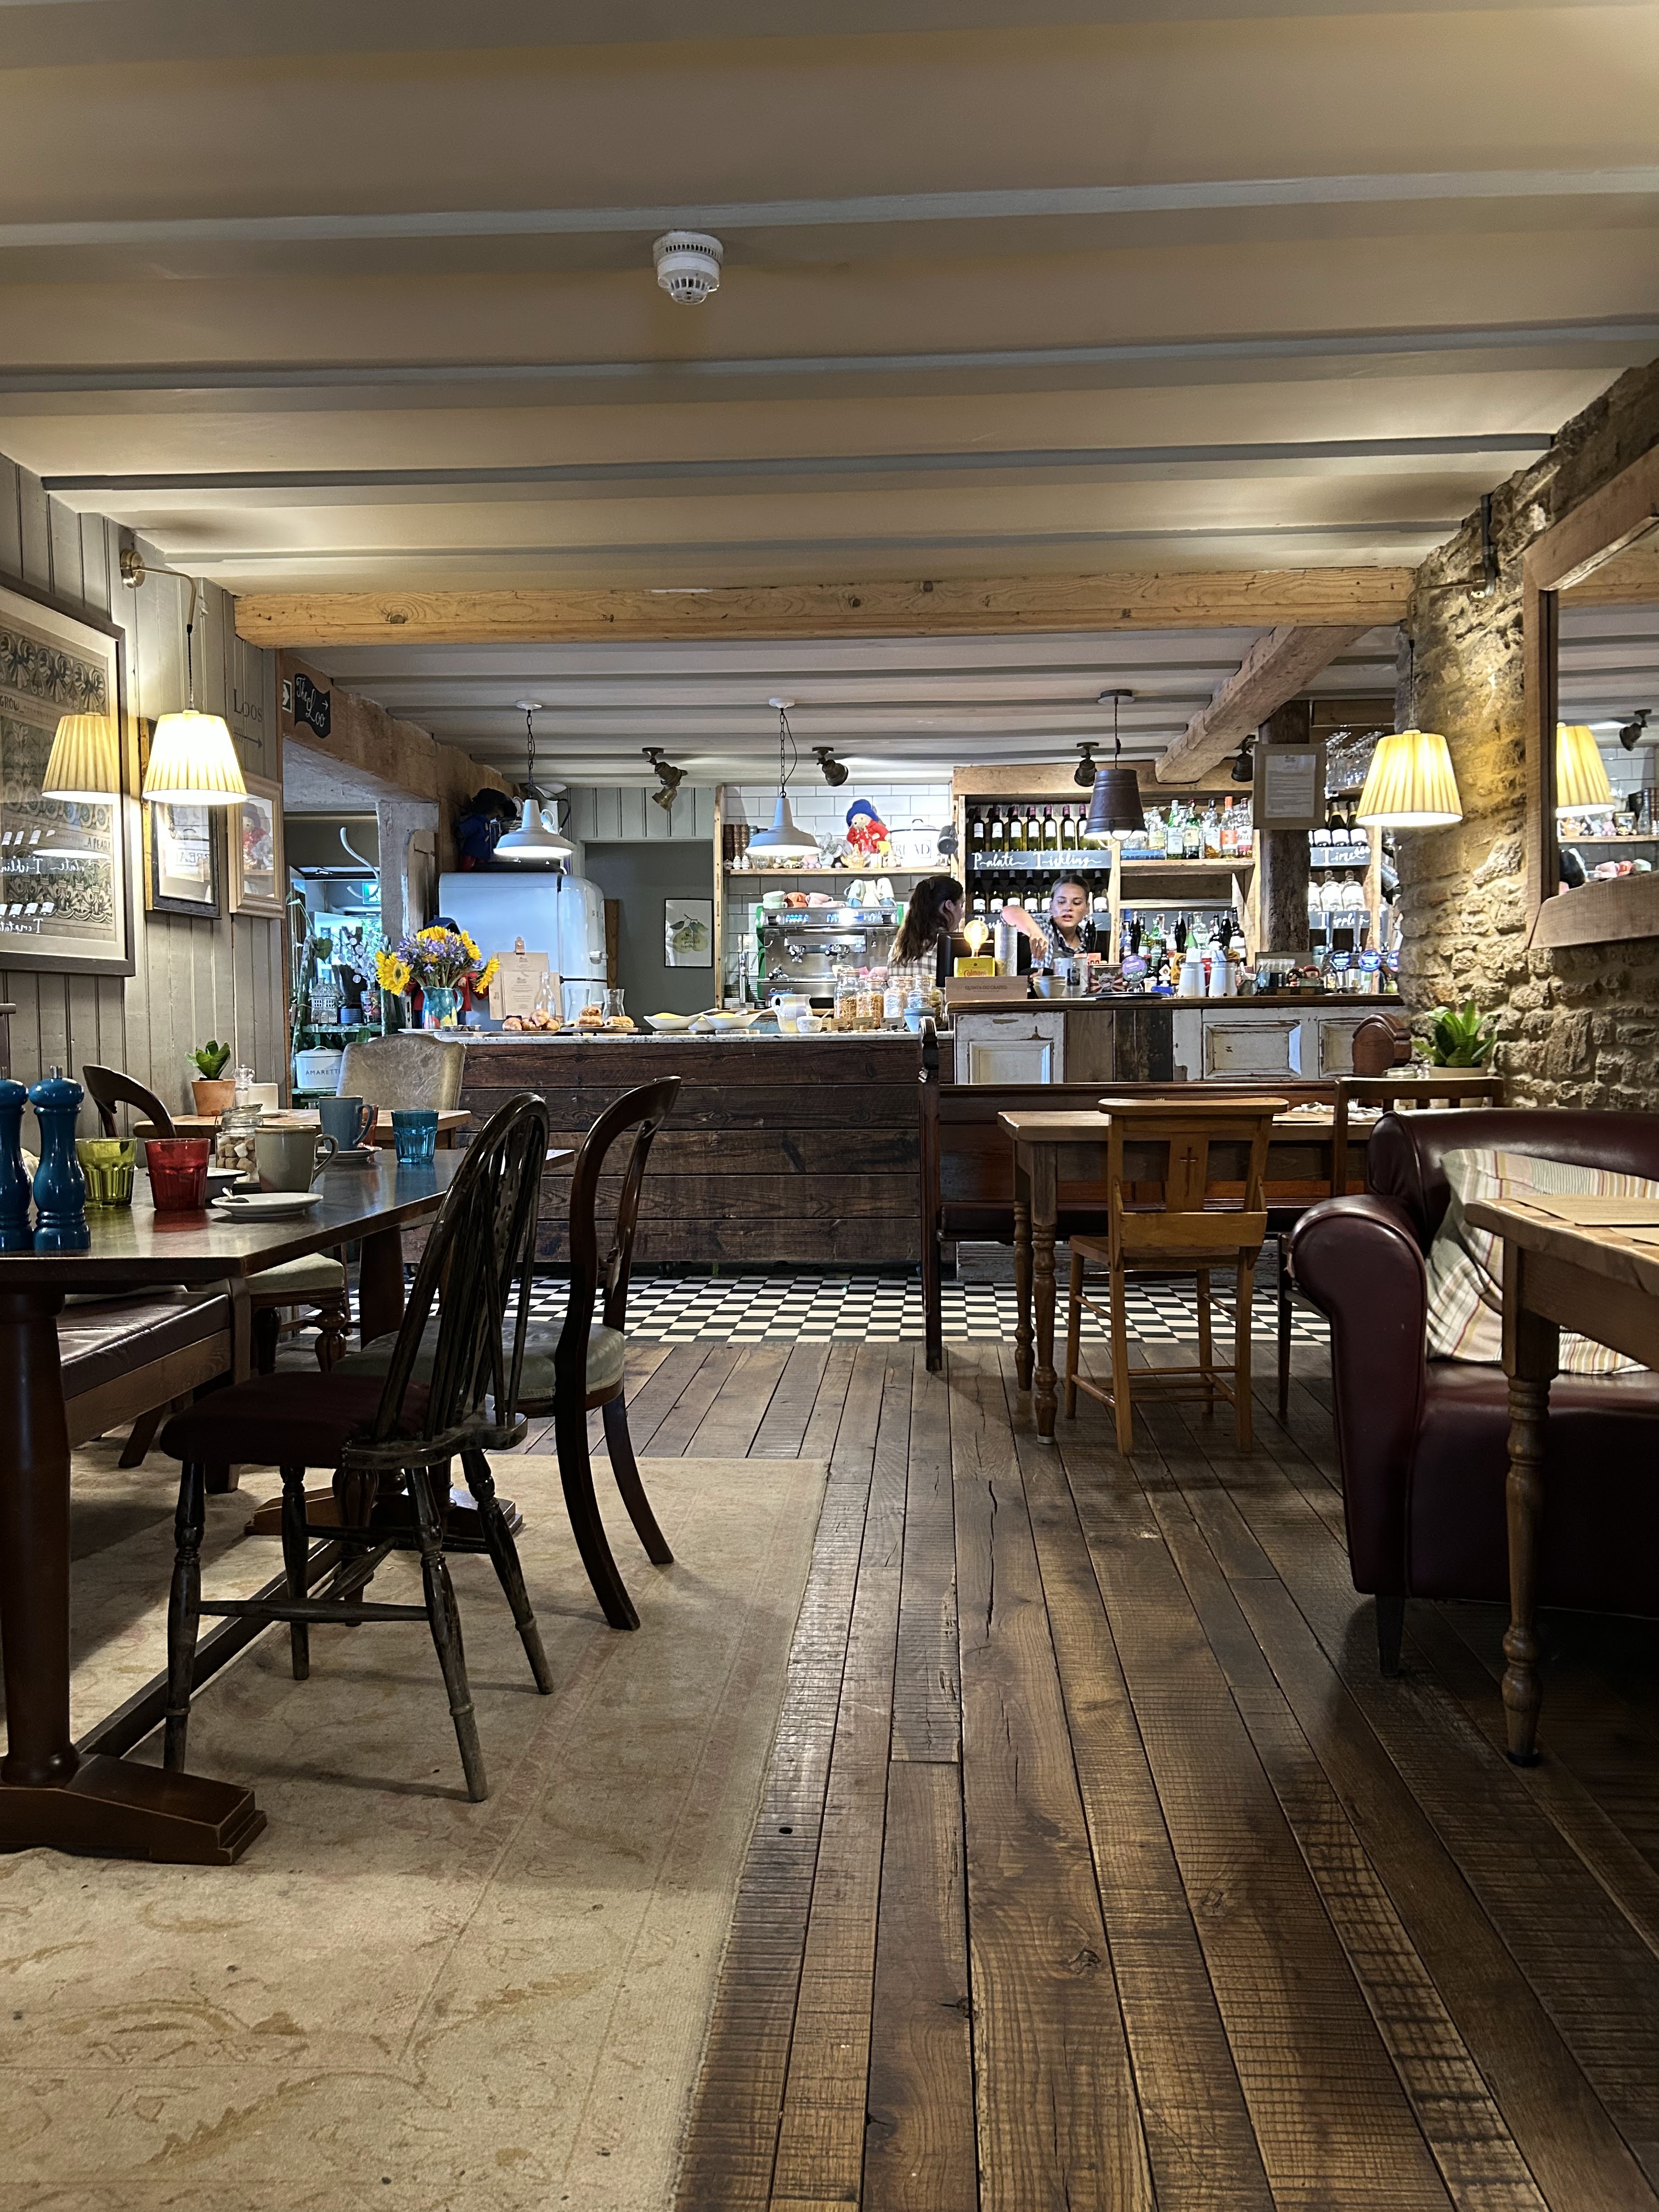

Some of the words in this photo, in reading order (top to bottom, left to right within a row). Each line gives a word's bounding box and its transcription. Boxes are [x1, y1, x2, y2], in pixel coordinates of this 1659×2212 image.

[296, 677, 308, 702] The
[234, 689, 263, 723] LOOS
[306, 689, 326, 727] Loo
[972, 852, 1028, 870] Palate
[1032, 851, 1102, 870] Tickling
